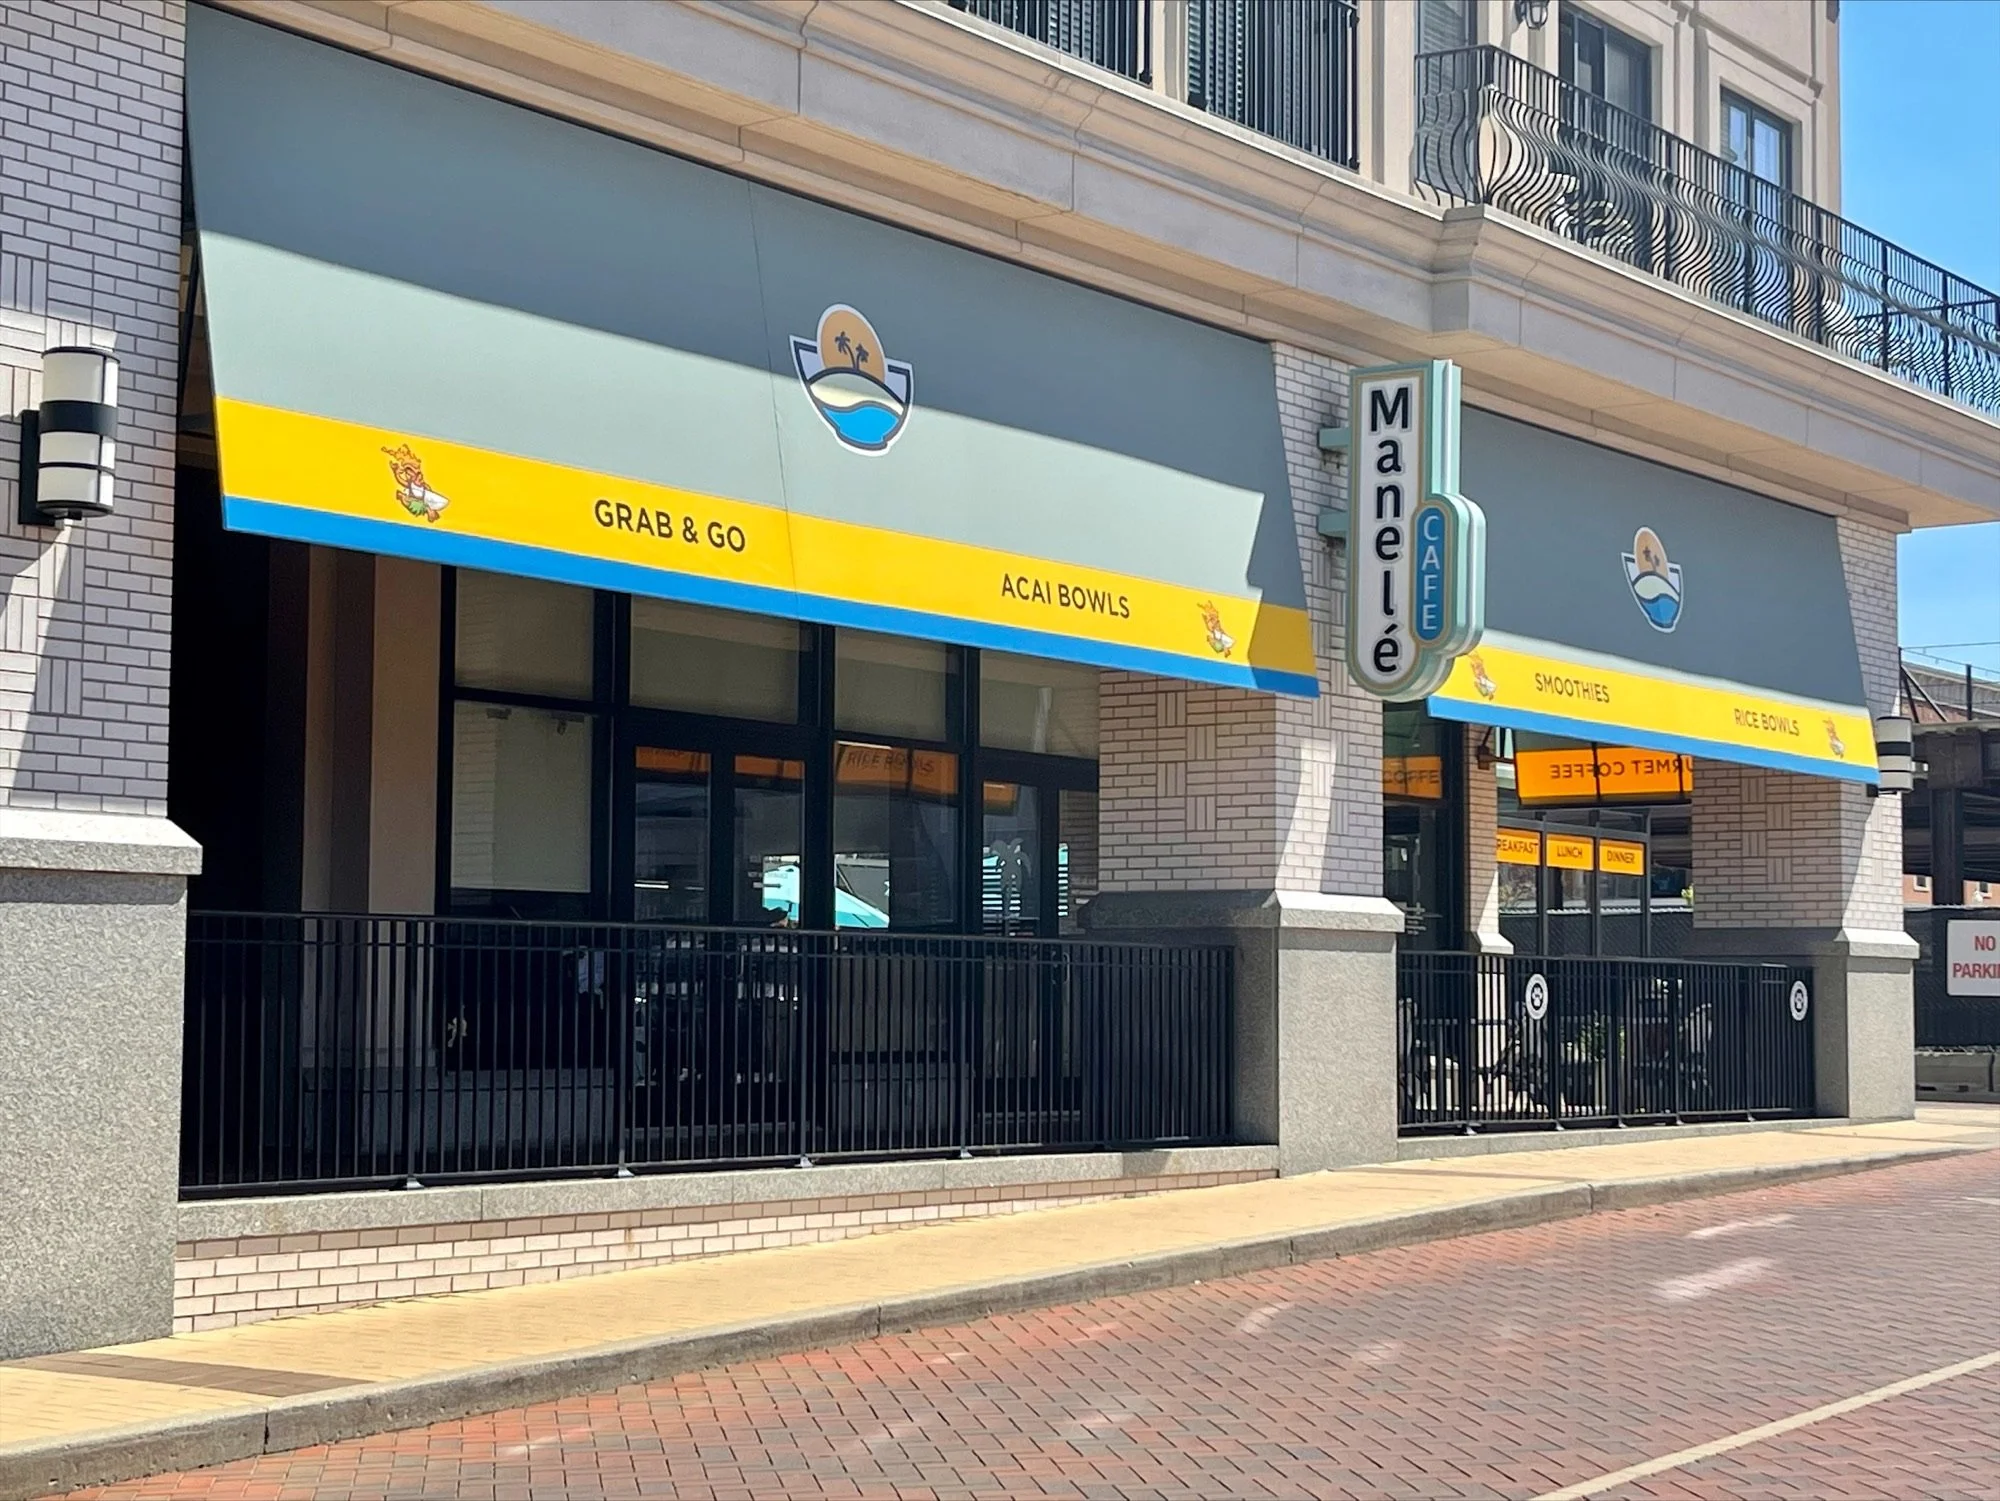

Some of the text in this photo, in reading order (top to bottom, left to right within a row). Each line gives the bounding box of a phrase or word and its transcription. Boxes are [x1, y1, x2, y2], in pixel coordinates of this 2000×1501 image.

[594, 499, 746, 553] GRAB & GO
[1370, 386, 1409, 674] Manelé
[1421, 514, 1441, 631] CAFE
[1001, 573, 1130, 620] ACAI BOWLS
[1534, 672, 1611, 703] SMOOTHIES
[1733, 708, 1801, 737] RICE BOWLS
[1556, 845, 1584, 860] LUNCH
[1606, 850, 1636, 865] DINNER
[1974, 935, 1997, 952] NO
[1952, 962, 2000, 979] PARKI
